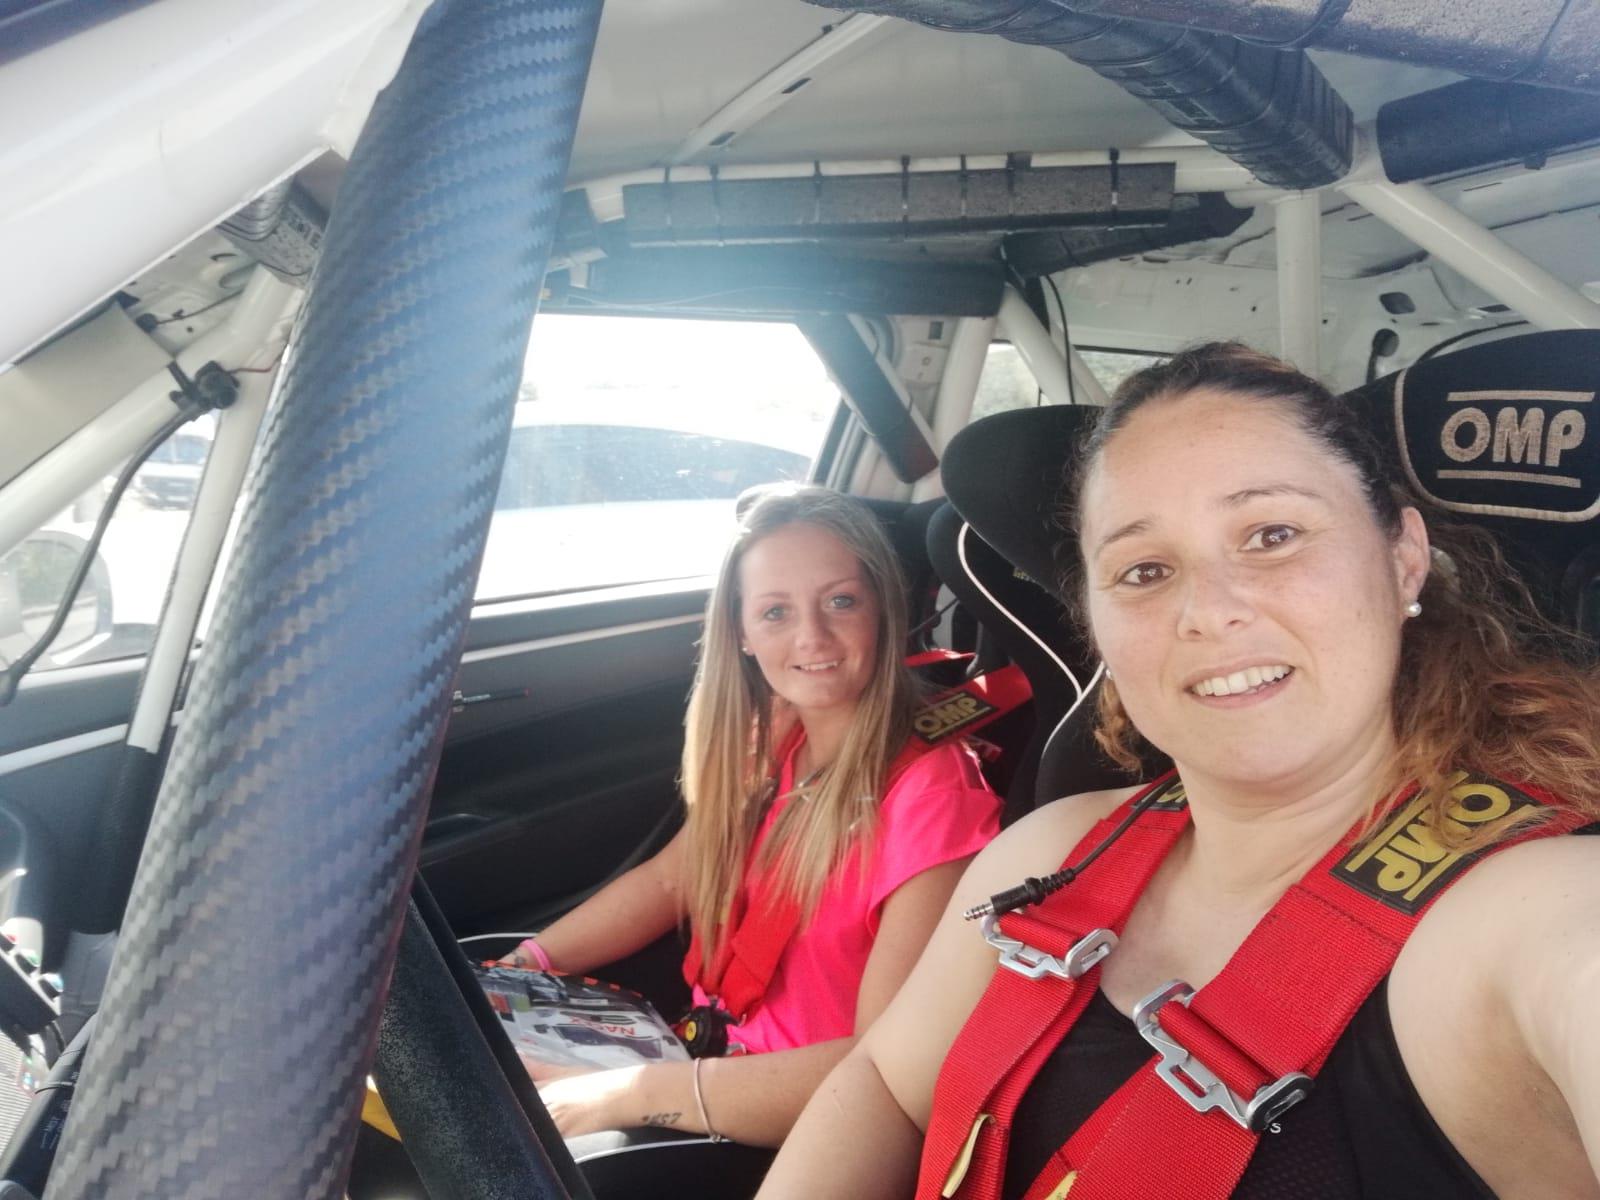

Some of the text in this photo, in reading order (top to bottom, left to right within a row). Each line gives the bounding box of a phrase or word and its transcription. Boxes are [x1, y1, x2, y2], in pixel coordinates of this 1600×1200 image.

[1441, 407, 1586, 467] OMP
[915, 697, 977, 734] OMP
[1374, 783, 1511, 892] OMP
